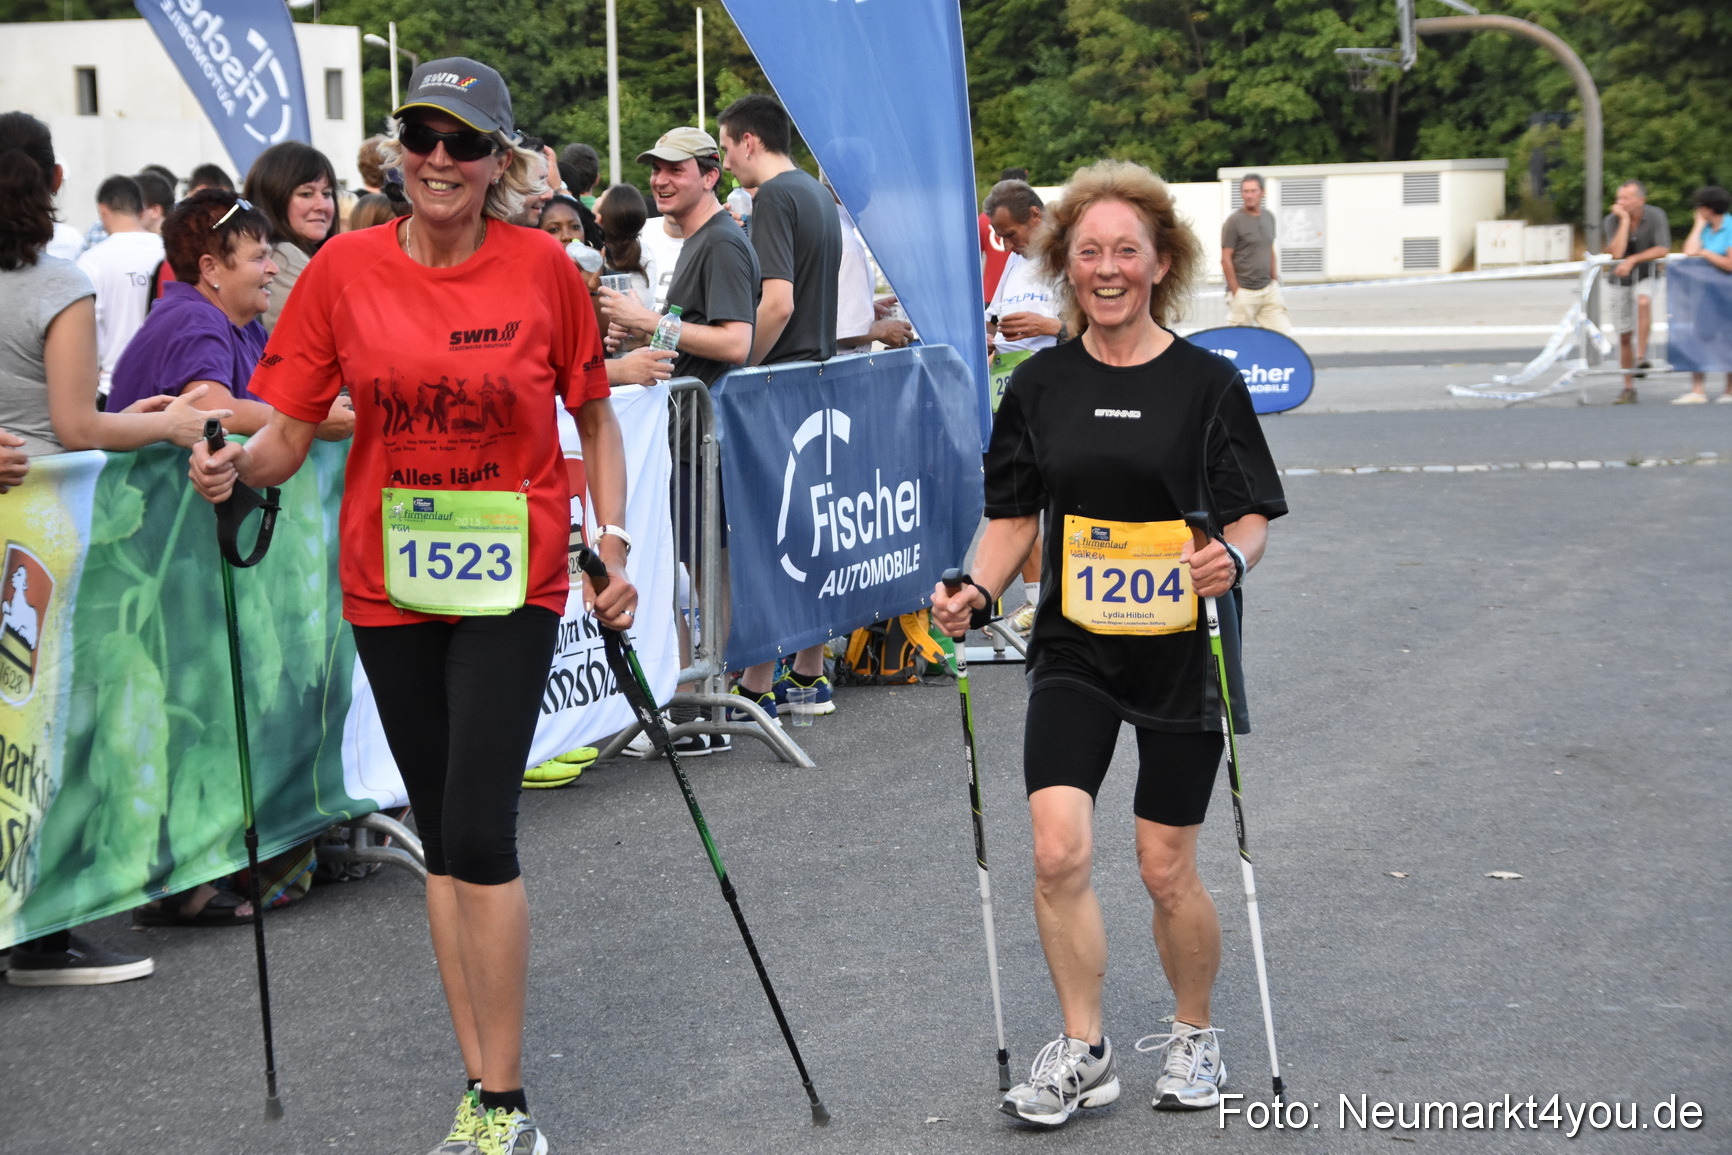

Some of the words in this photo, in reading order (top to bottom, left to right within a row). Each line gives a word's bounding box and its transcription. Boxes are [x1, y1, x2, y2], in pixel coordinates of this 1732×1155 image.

[421, 72, 460, 86] swn
[449, 328, 498, 345] swn
[393, 468, 442, 486] Alles
[450, 462, 500, 484] läuft
[404, 509, 454, 521] firmenlauf
[1083, 537, 1128, 549] firmenlauf
[399, 540, 513, 582] 1523
[818, 543, 921, 599] AUTOMOBILE
[1077, 565, 1184, 604] 1204
[1103, 611, 1125, 619] Lydia
